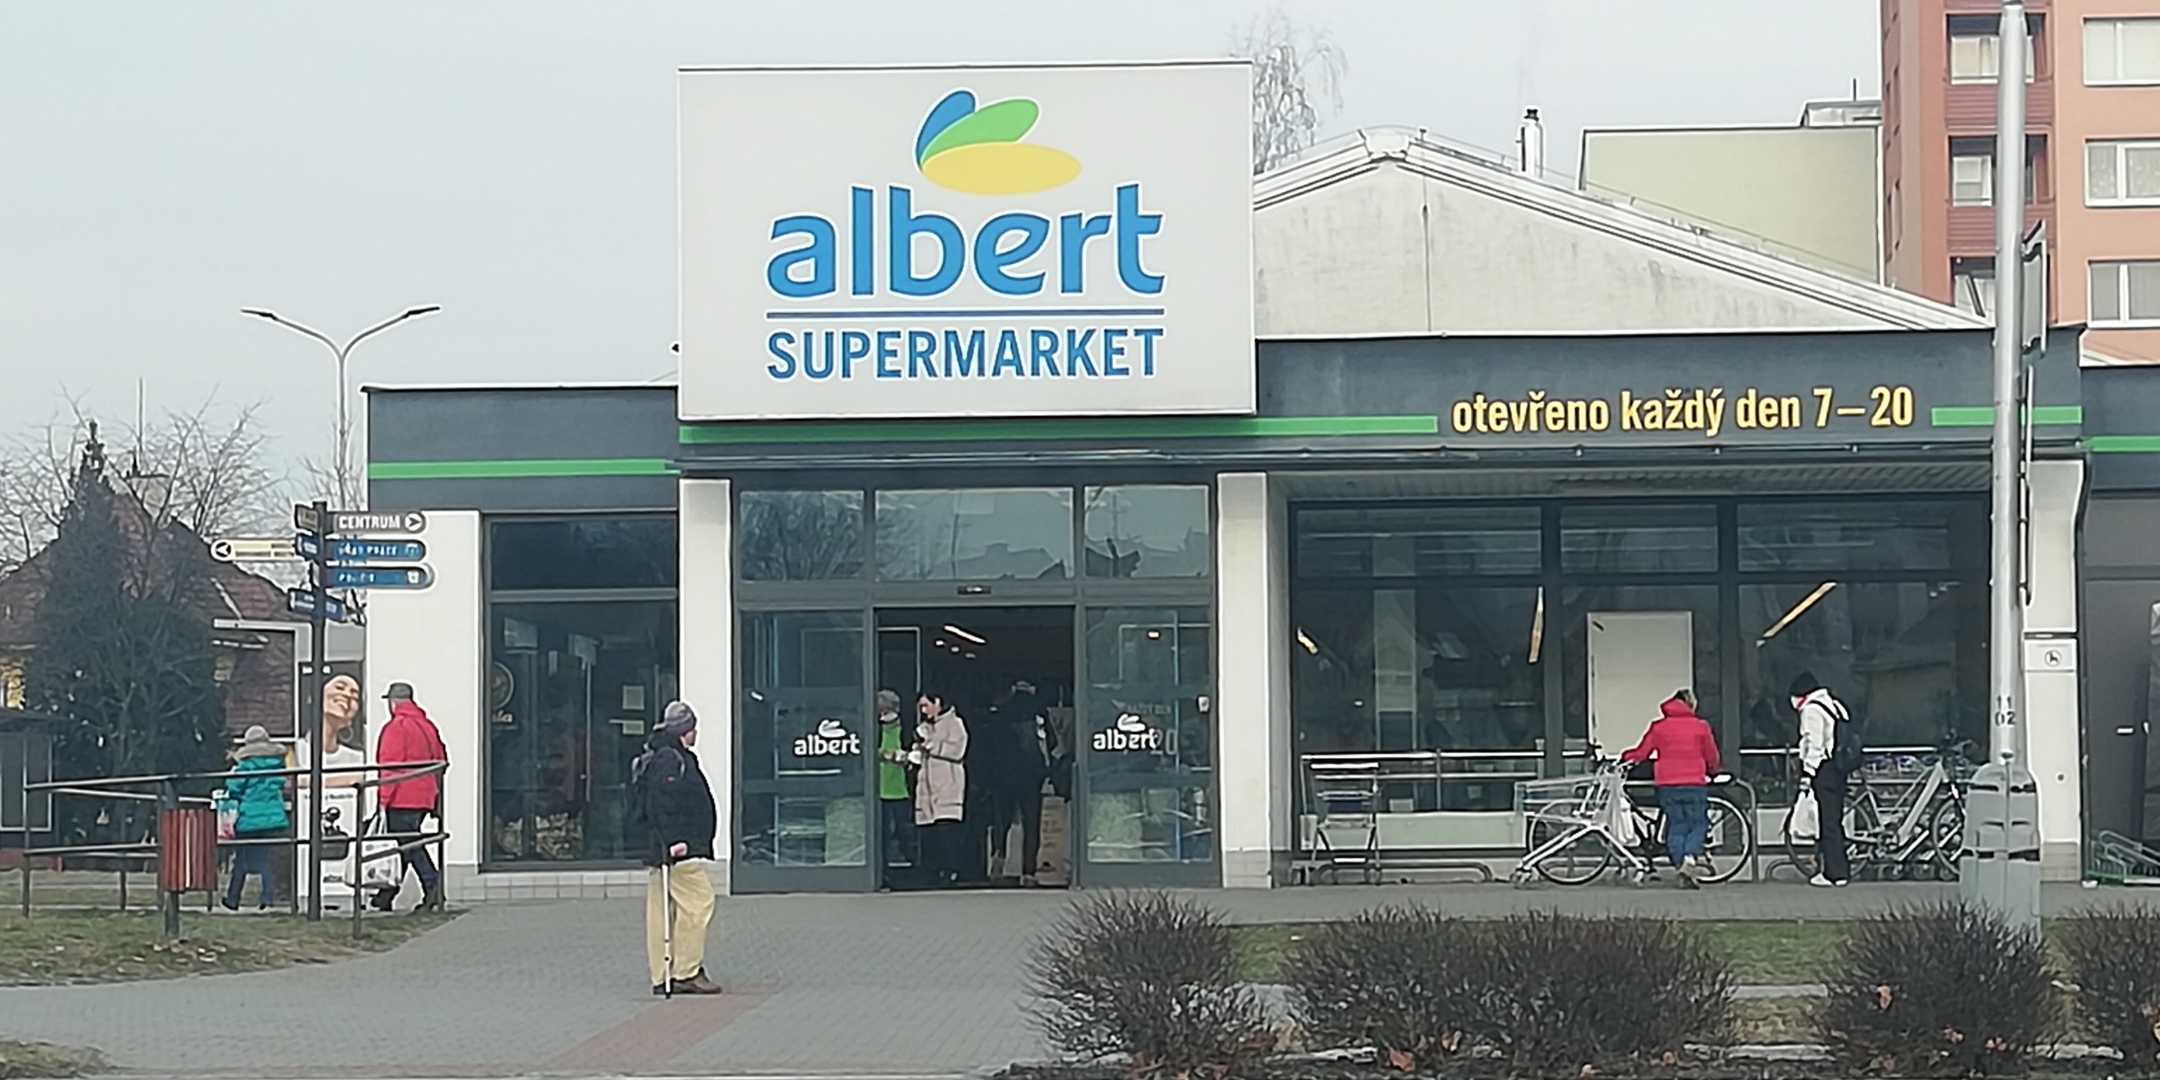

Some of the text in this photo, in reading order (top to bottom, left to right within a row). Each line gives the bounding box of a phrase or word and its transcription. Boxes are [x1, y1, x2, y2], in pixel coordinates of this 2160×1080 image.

[767, 183, 1165, 297] albert
[766, 328, 1164, 380] SUPERMARKET
[1452, 391, 1609, 433] otevřeno
[1620, 388, 1724, 436] každý
[1736, 388, 1801, 429] den
[338, 515, 401, 530] CENTRUM
[793, 729, 860, 756] albert
[1092, 728, 1158, 751] albert
